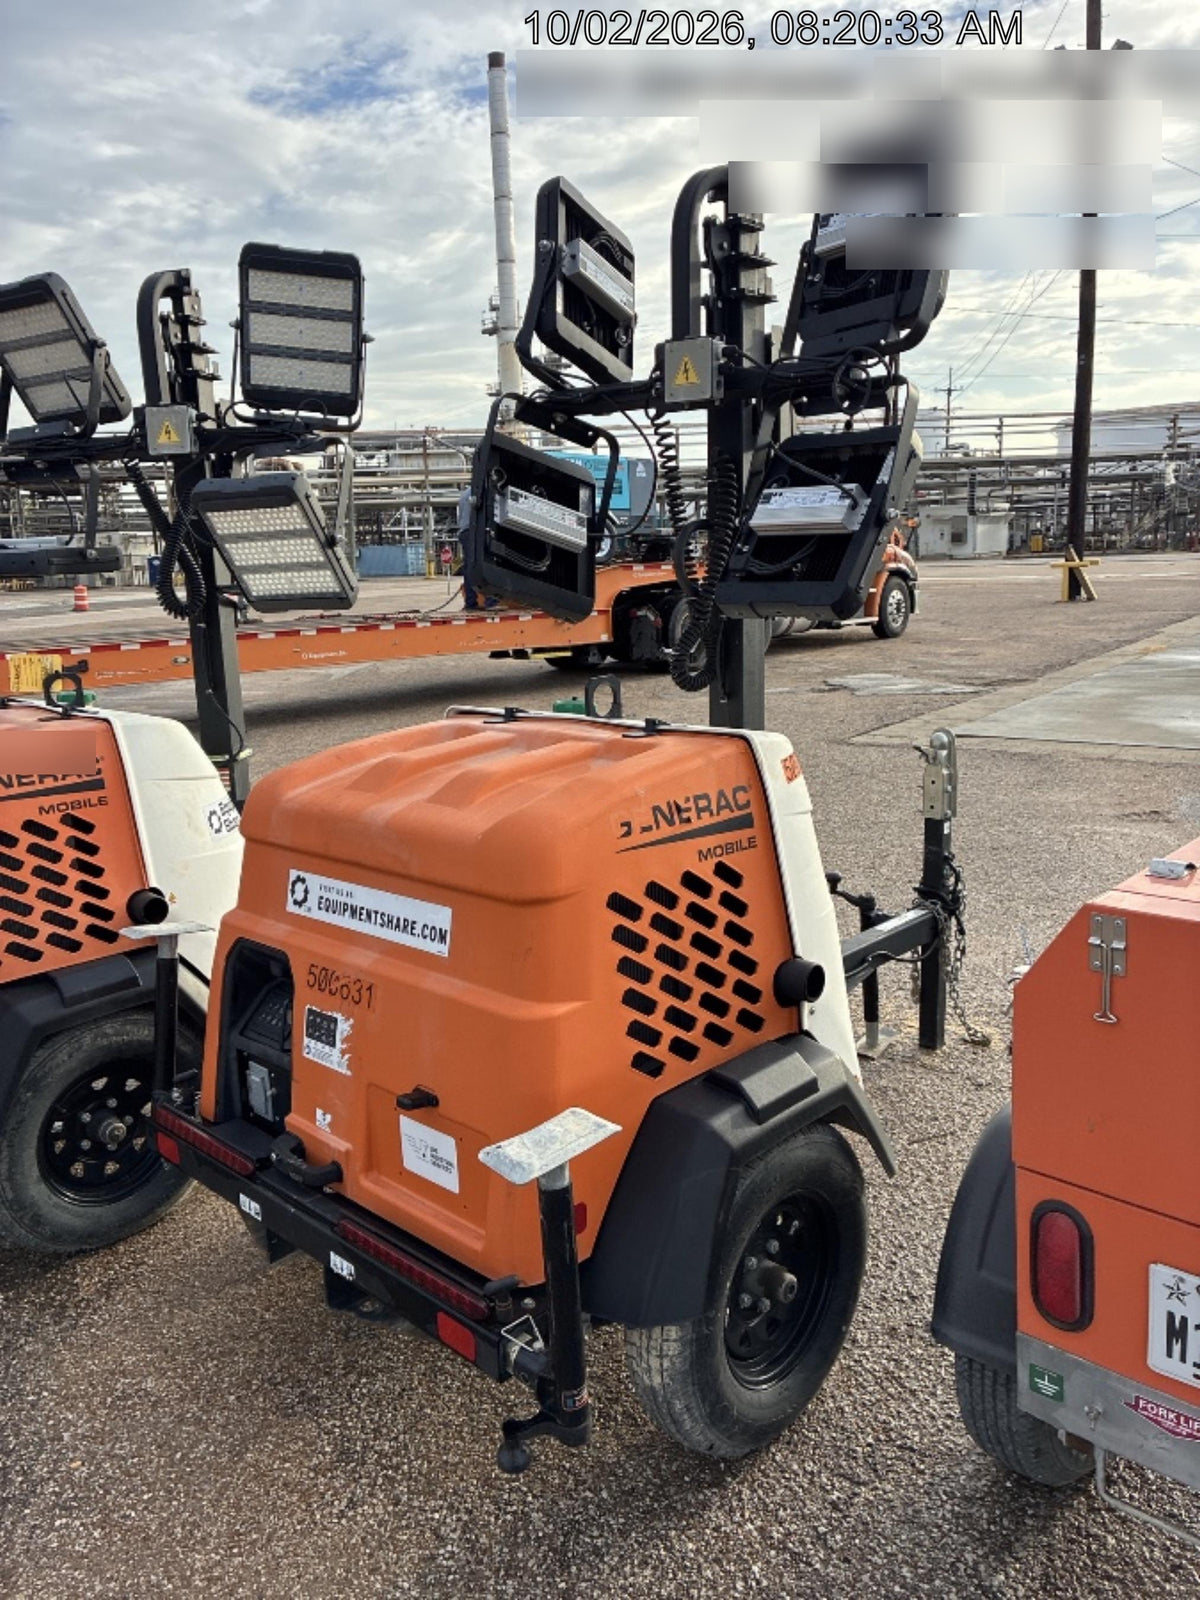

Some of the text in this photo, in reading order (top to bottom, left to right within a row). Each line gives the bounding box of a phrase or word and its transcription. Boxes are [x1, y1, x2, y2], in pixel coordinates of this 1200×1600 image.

[38, 796, 109, 816] MOBILE
[697, 835, 758, 863] MOBILE
[317, 895, 448, 946] EQUIPMENTSHARE.COM
[1139, 1399, 1178, 1424] FORK
